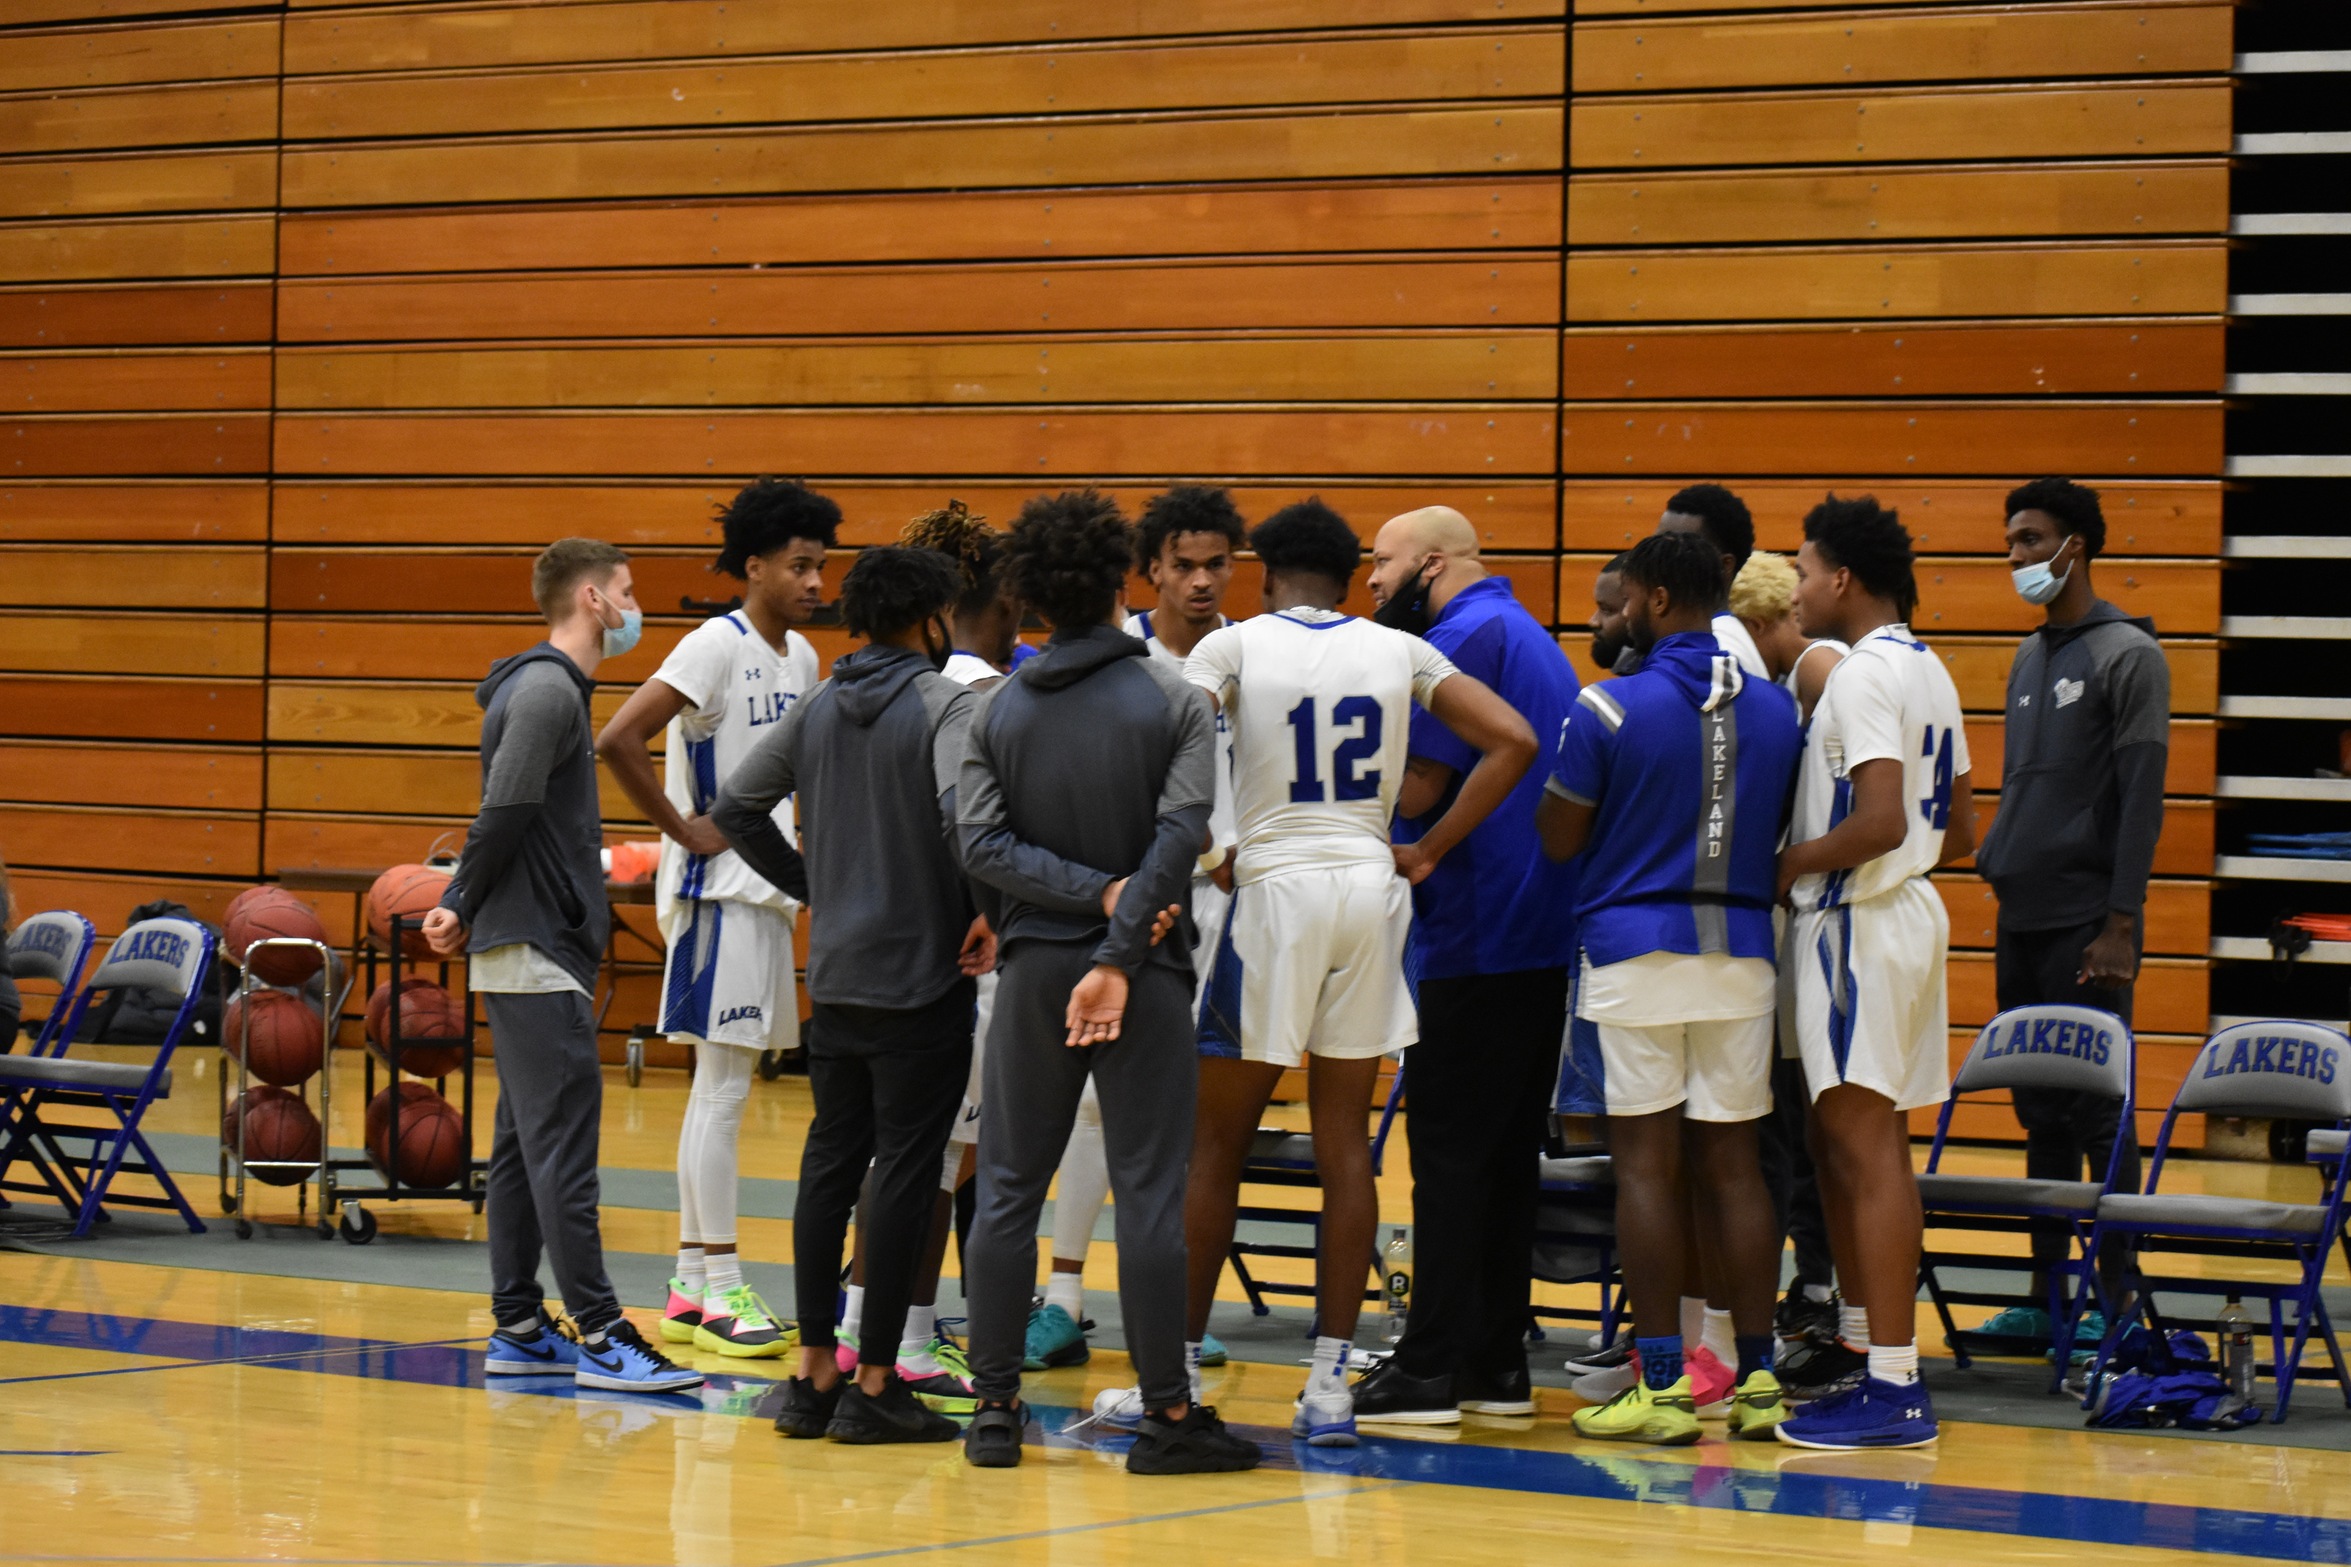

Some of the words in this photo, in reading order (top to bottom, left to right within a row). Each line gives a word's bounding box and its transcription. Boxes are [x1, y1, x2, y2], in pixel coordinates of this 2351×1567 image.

[747, 692, 798, 726] LAK
[1288, 696, 1383, 803] 12
[1708, 707, 1727, 858] LAKELAND
[108, 930, 191, 969] LAKERS
[1983, 1019, 2113, 1066] LAKERS
[2204, 1036, 2340, 1085] LAKERS
